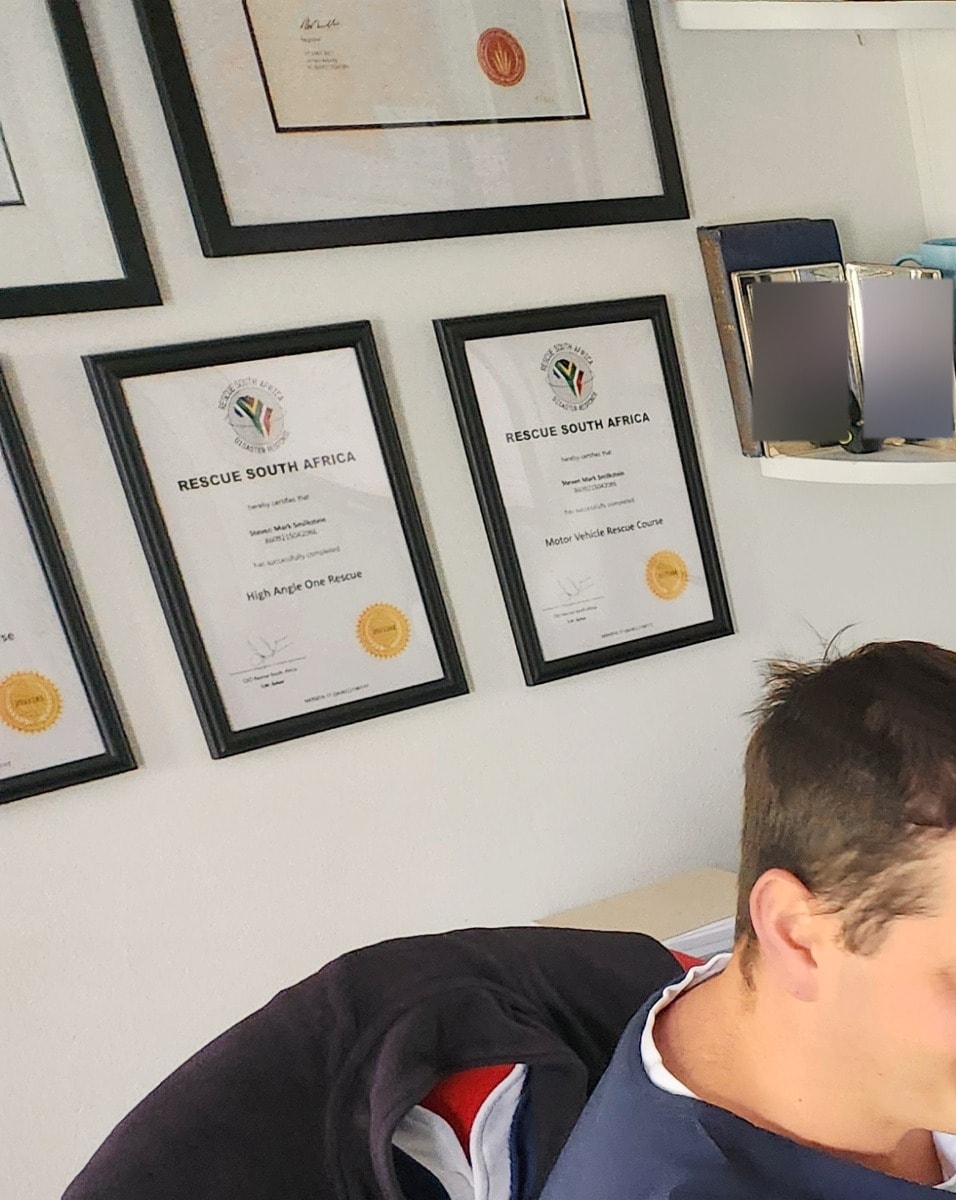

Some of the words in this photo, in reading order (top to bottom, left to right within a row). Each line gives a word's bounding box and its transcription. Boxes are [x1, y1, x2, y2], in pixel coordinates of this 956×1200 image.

[505, 426, 558, 443] RESCUE
[561, 419, 604, 435] SOUTH
[607, 412, 651, 428] AFRICA
[177, 469, 243, 492] RESCUE
[245, 460, 300, 481] SOUTH
[303, 450, 357, 470] AFRICA
[544, 535, 573, 548] Motor
[573, 528, 605, 542] Vehicle
[606, 523, 635, 535] Rescue
[636, 517, 664, 530] Course
[246, 588, 272, 602] High
[273, 582, 303, 597] Angle
[304, 577, 326, 590] One
[327, 570, 363, 585] Rescue
